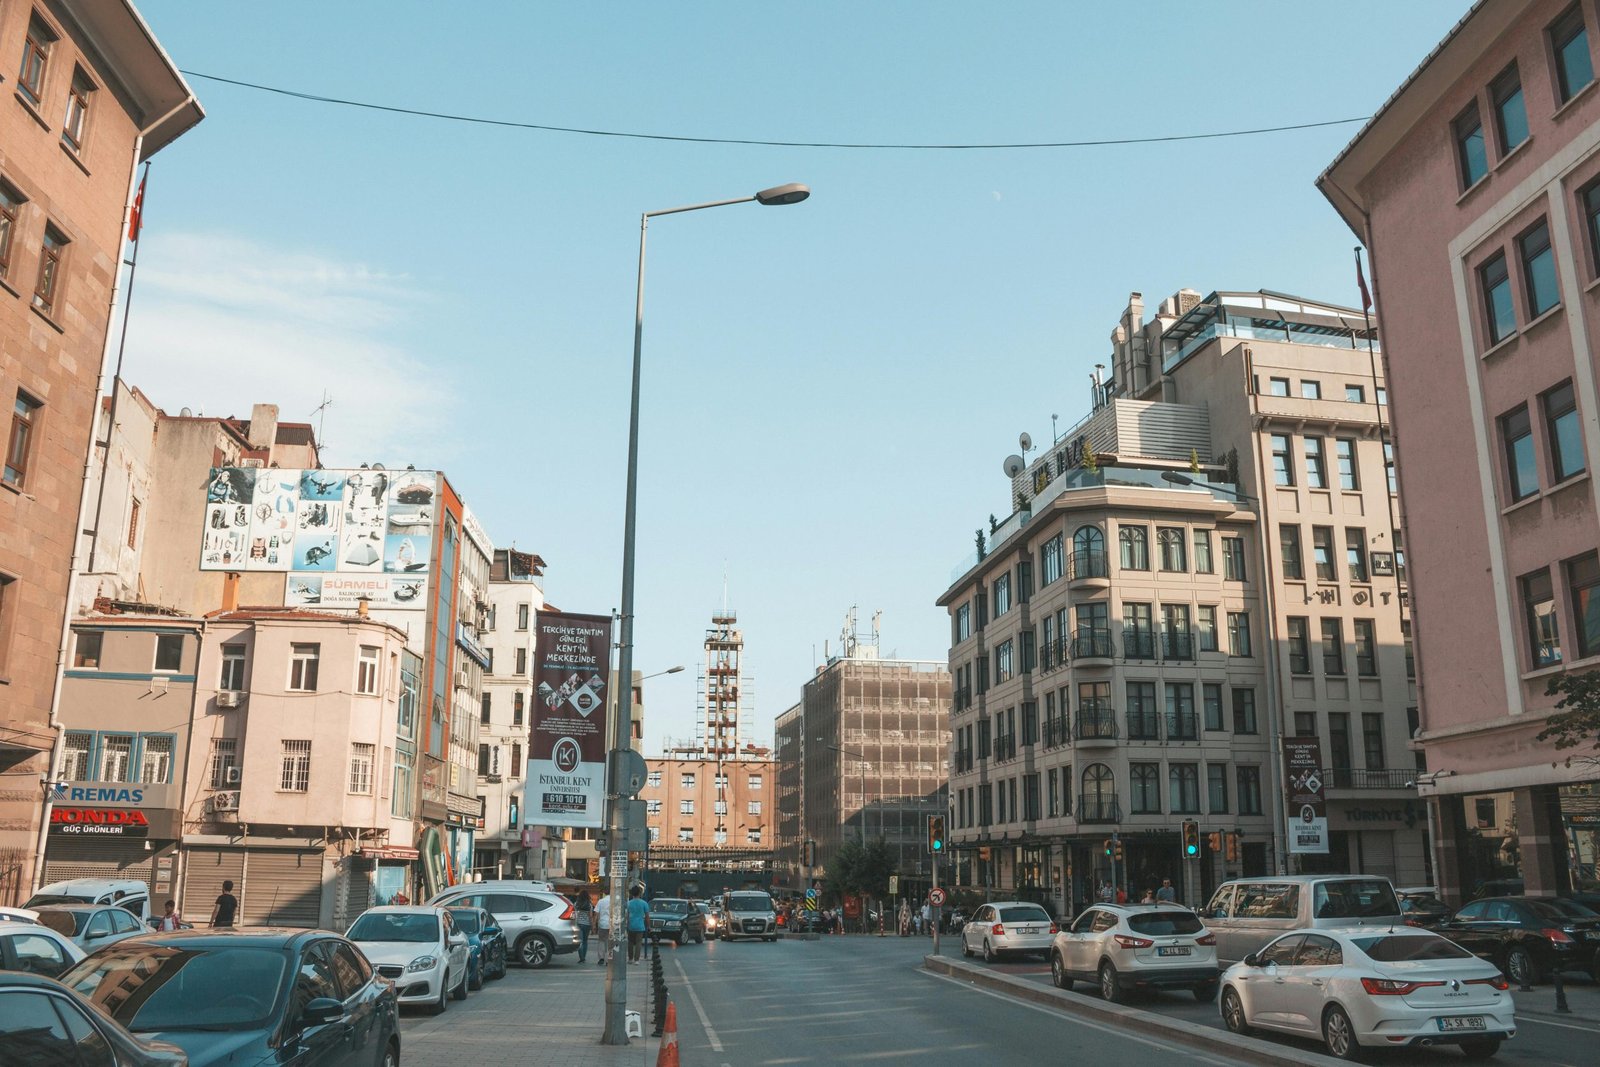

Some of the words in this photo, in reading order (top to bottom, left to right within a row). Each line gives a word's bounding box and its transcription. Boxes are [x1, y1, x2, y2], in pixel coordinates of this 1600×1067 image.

[542, 625, 567, 635] TERCİH
[566, 627, 576, 635] VE
[575, 627, 604, 637] TANITIM
[559, 634, 586, 644] GÜNLERİ
[556, 643, 588, 653] KENT'İN
[546, 653, 597, 664] MERKEZİNDE
[539, 773, 572, 786] İSTANBUL
[572, 776, 592, 787] KENT
[549, 794, 564, 803] 610
[1344, 807, 1403, 821] TÜRKİYE
[63, 824, 82, 833] GÜÇ
[83, 825, 123, 834] ÜRÜNLERİ
[1443, 1017, 1453, 1027] 34
[1454, 1017, 1465, 1027] SK
